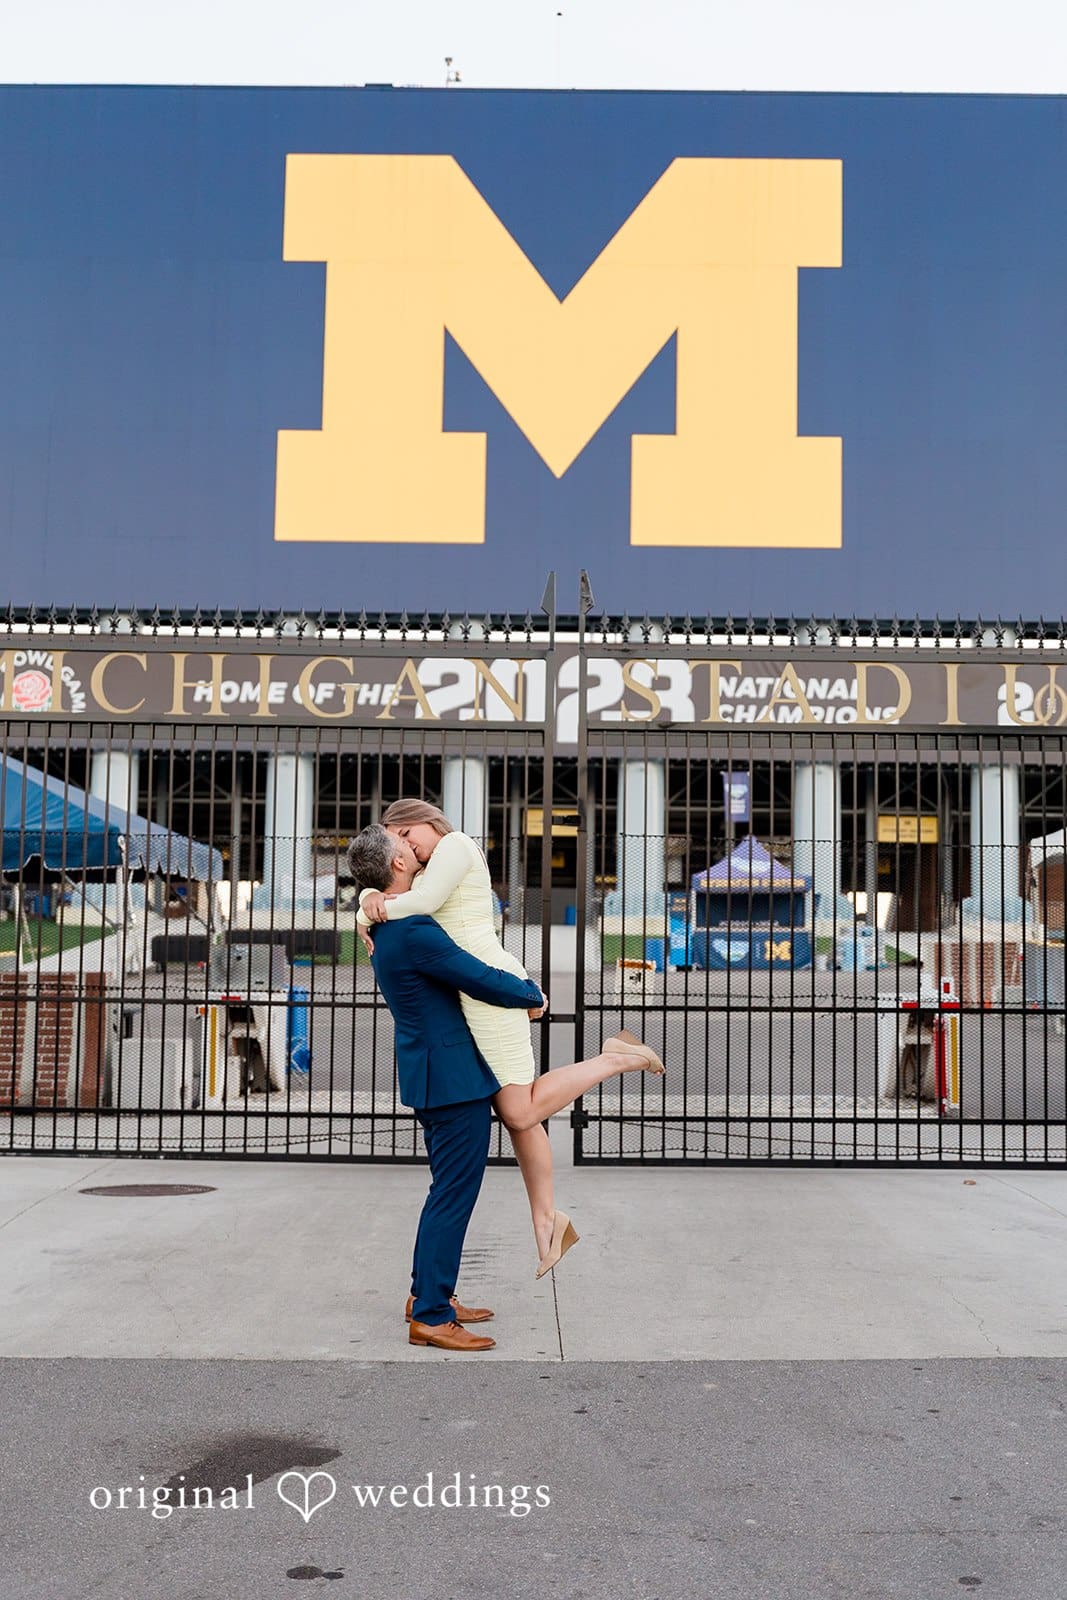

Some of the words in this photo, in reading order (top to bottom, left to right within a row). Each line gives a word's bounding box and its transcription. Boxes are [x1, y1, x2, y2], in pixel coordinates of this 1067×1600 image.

[274, 153, 843, 549] M
[3, 650, 55, 672] OWL
[61, 666, 87, 714] GAM
[193, 680, 288, 704] HOME
[292, 681, 336, 706] OF
[339, 682, 403, 707] HE
